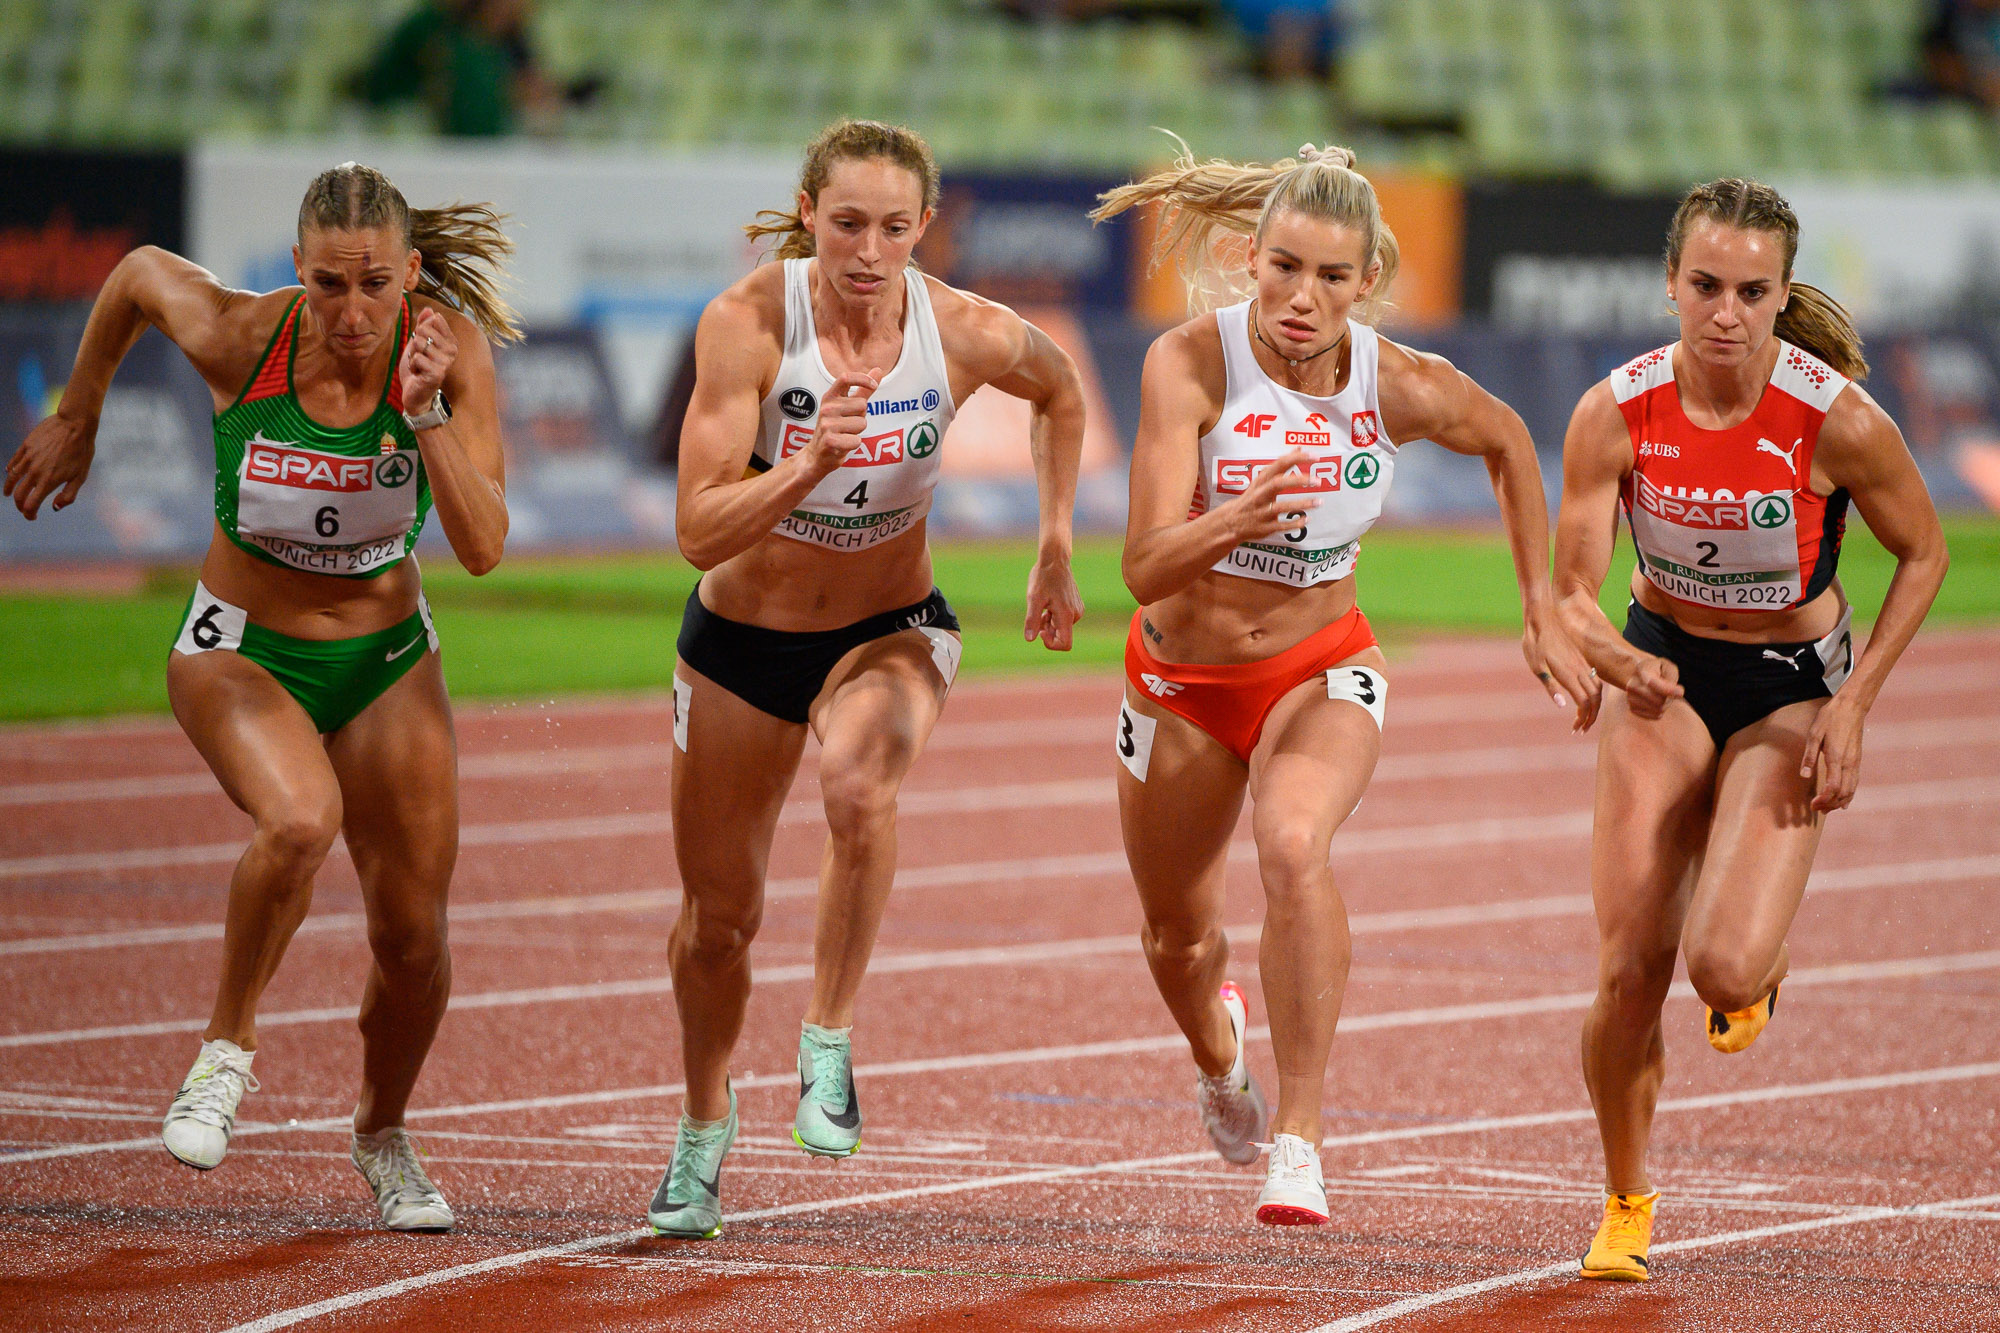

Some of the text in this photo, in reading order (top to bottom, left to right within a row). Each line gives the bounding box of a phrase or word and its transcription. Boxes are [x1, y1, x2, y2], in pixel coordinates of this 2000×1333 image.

[866, 399, 919, 416] Allianz
[1233, 413, 1277, 438] 4F
[1287, 432, 1328, 444] ORLEN
[786, 430, 901, 463] SAR
[1653, 442, 1681, 459] UBS
[251, 450, 369, 488] SPAR
[843, 480, 869, 510] 4
[1639, 482, 1745, 526] SPAR
[315, 506, 340, 538] 6
[806, 512, 810, 521] I
[815, 514, 846, 528] RUN
[868, 511, 911, 544] 2022
[347, 540, 395, 570] 2022
[1227, 550, 1305, 582] UNICH
[1695, 541, 1721, 568] 2
[1648, 565, 1792, 604] MUNICH 2022
[1669, 563, 1756, 585] I RUN CLEAN
[192, 604, 224, 649] 6
[1140, 672, 1185, 698] 4F
[1350, 670, 1377, 706] 3
[1119, 707, 1136, 758] 3
